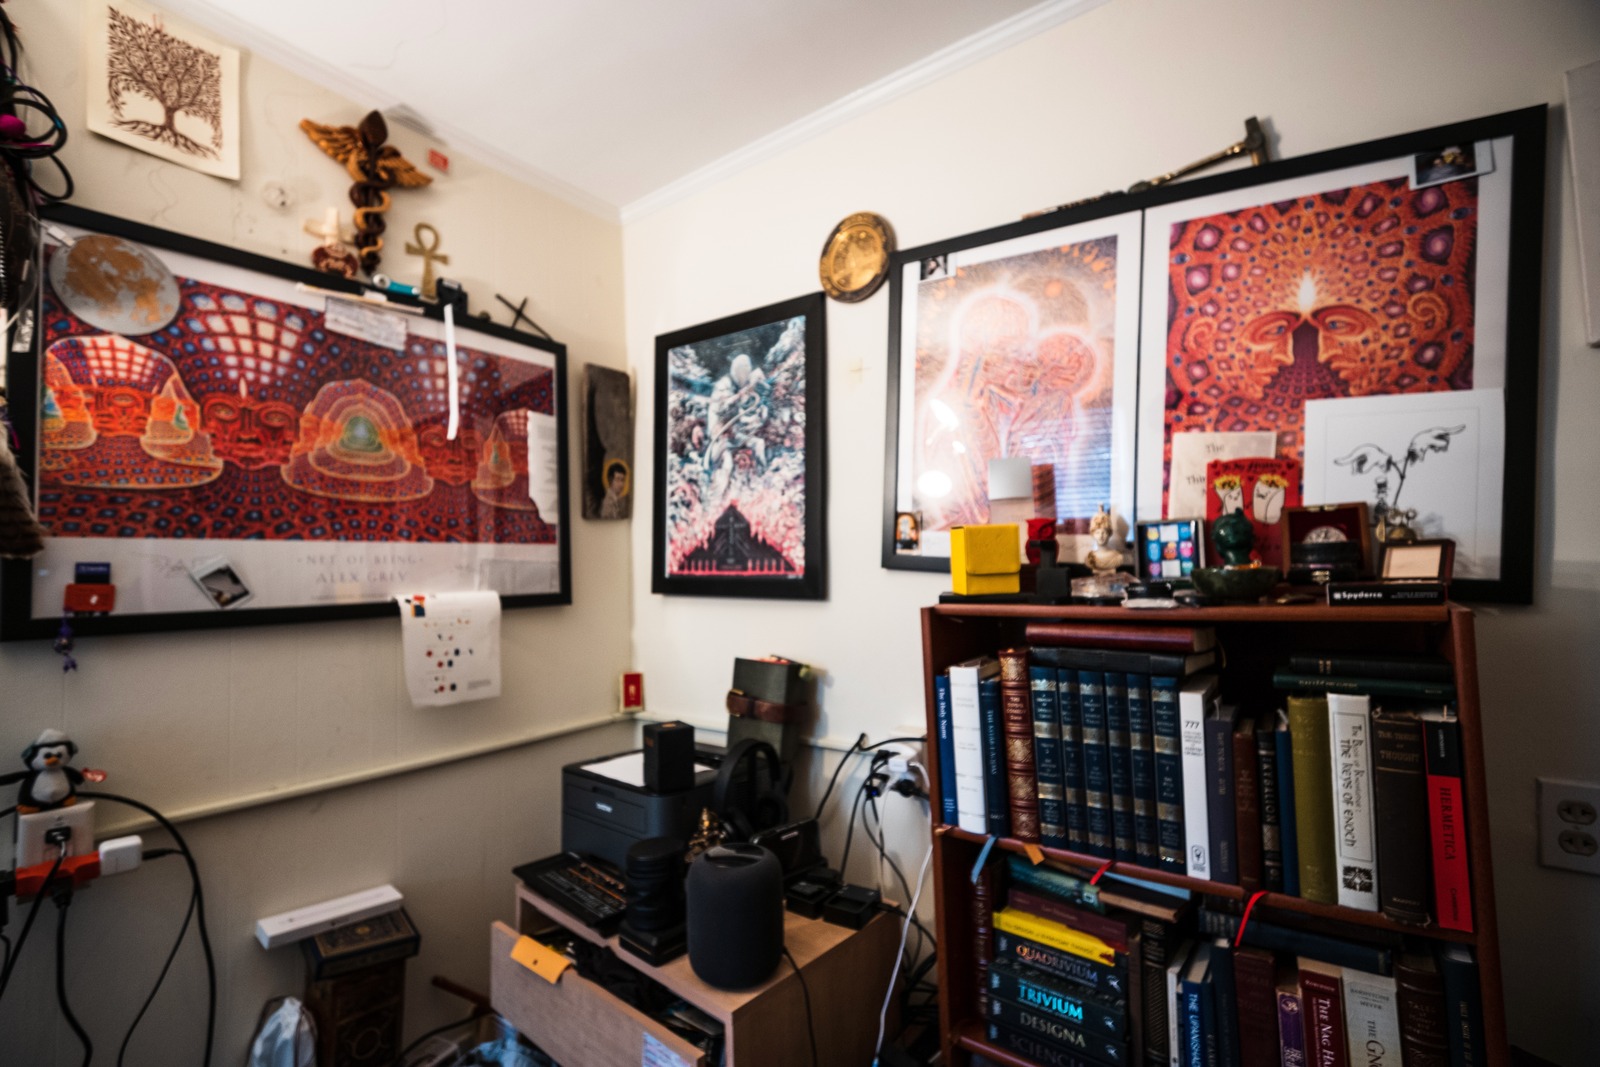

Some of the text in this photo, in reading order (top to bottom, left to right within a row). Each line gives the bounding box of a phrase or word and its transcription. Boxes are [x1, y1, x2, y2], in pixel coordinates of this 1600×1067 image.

[346, 555, 364, 564] OF
[316, 571, 408, 584] ALEX GREY
[1342, 590, 1383, 600] Spyderco
[1184, 720, 1200, 730] 777
[1440, 787, 1456, 861] HERMETICA
[1016, 944, 1098, 983] QUADRIVIUM
[1018, 985, 1084, 1020] TRIVIUM
[1188, 993, 1198, 1012] THE
[1019, 1012, 1086, 1048] DESIGNA
[1319, 1024, 1333, 1046] NAG
[1366, 1020, 1377, 1037] THE
